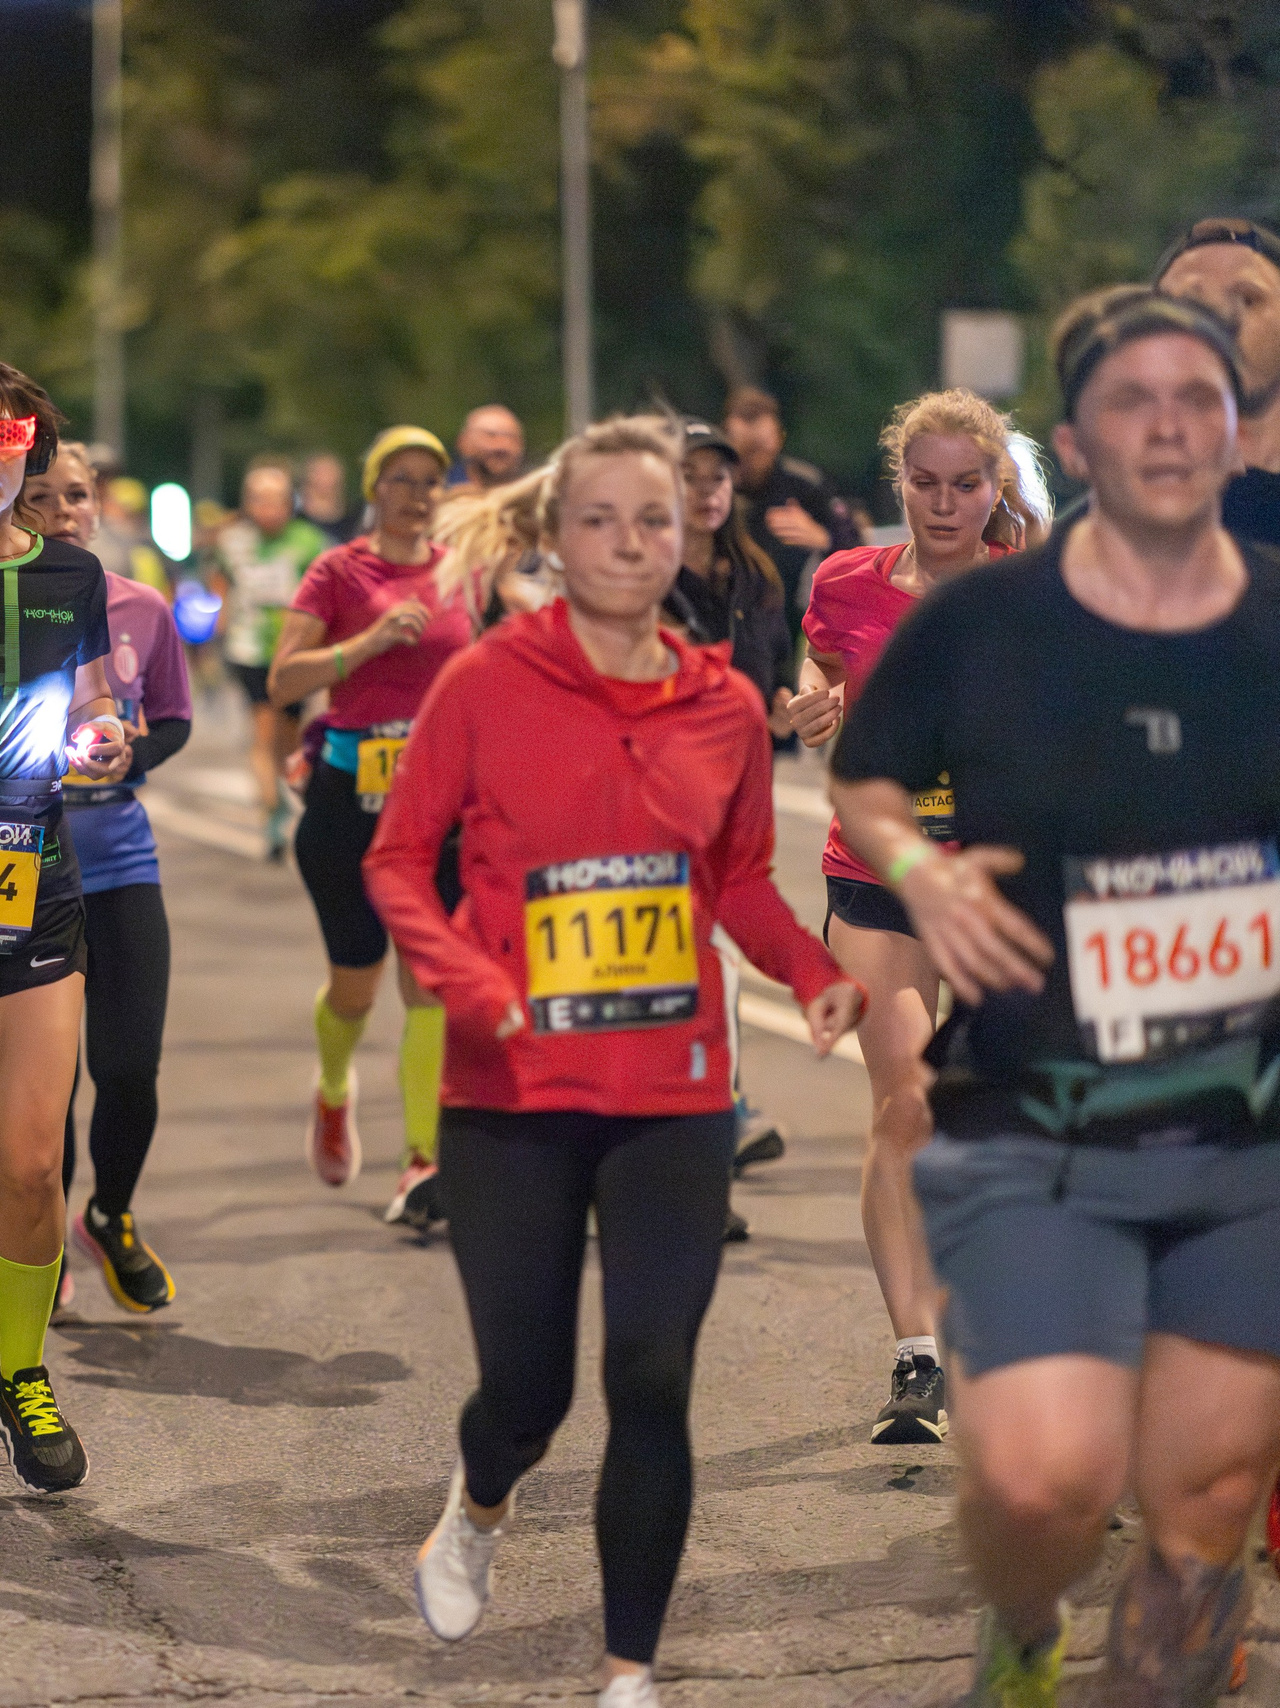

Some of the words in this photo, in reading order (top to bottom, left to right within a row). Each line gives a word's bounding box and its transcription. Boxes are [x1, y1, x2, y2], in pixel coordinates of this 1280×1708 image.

[537, 904, 685, 961] 11171
[1084, 909, 1272, 990] 18661
[548, 998, 572, 1030] E
